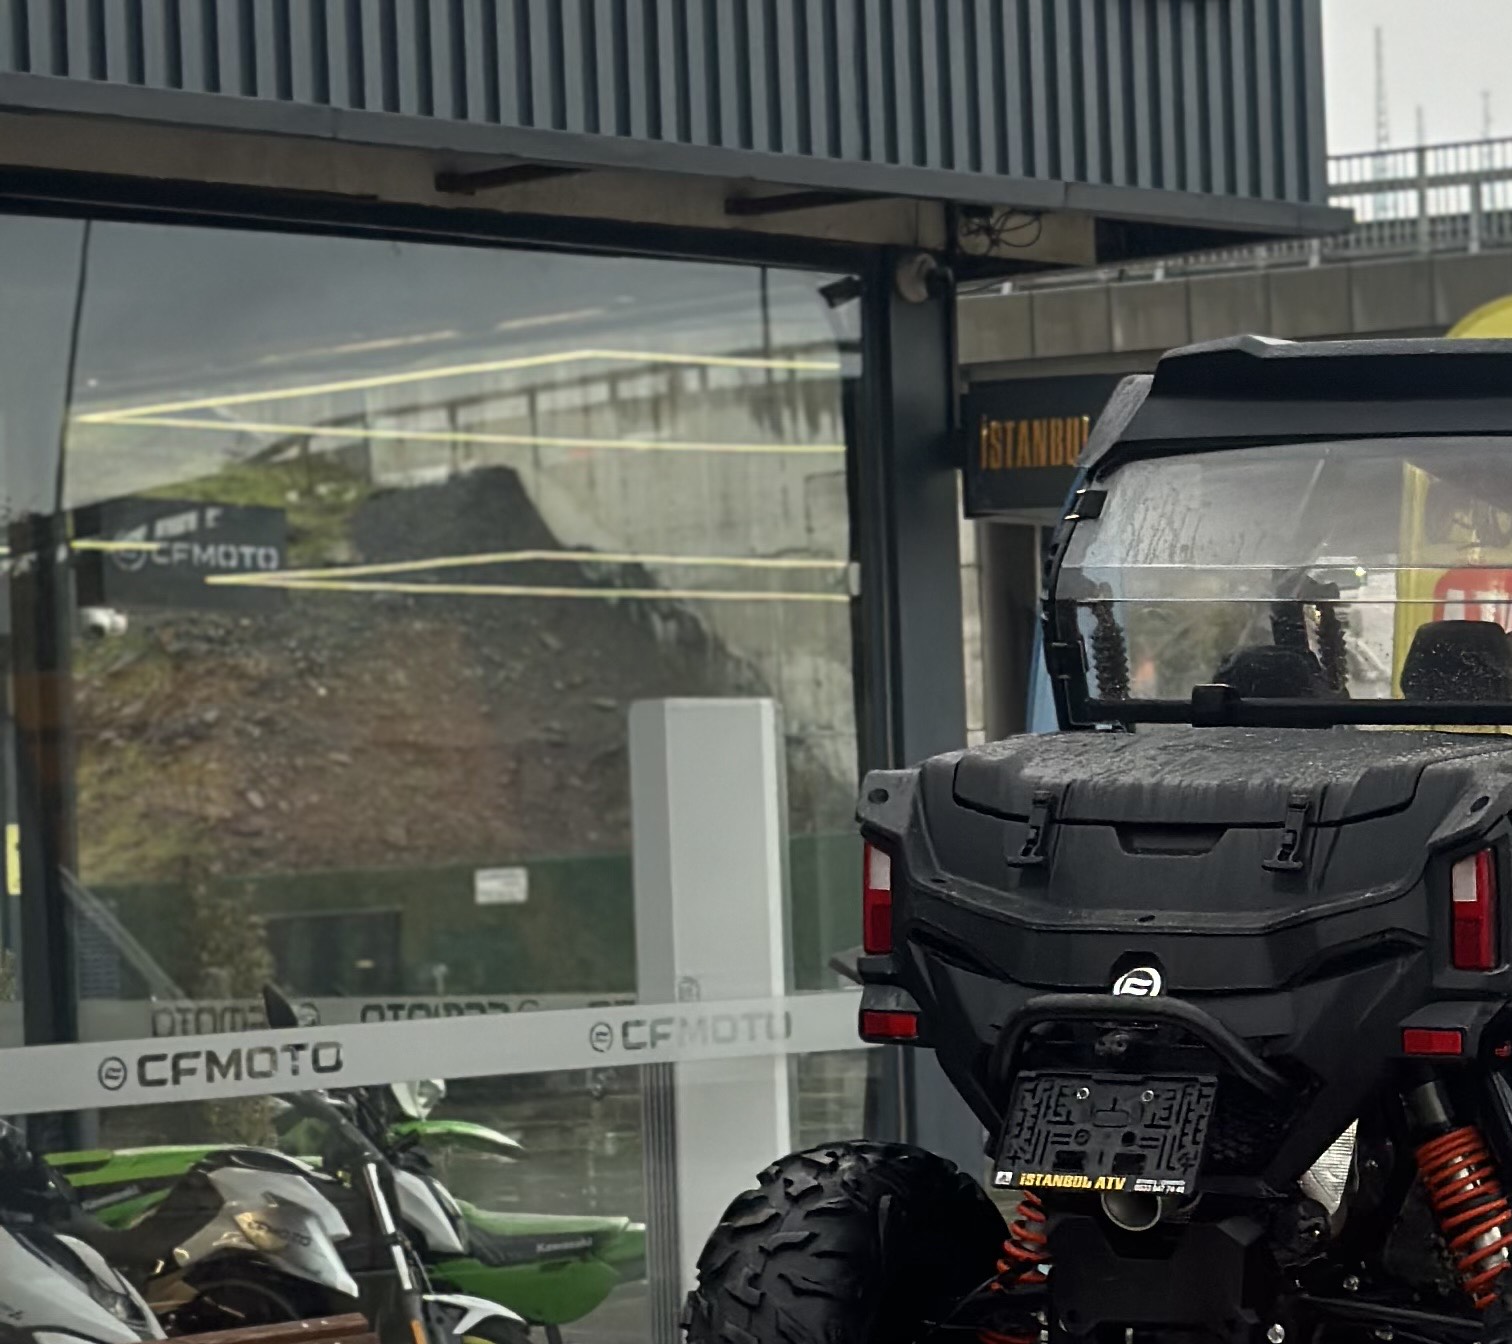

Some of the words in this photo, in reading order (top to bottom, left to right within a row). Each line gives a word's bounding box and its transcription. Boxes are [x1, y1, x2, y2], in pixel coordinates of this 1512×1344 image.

[621, 1010, 792, 1051] CFMOTO
[137, 1041, 344, 1088] CFMOTO
[1094, 1175, 1127, 1191] ATV
